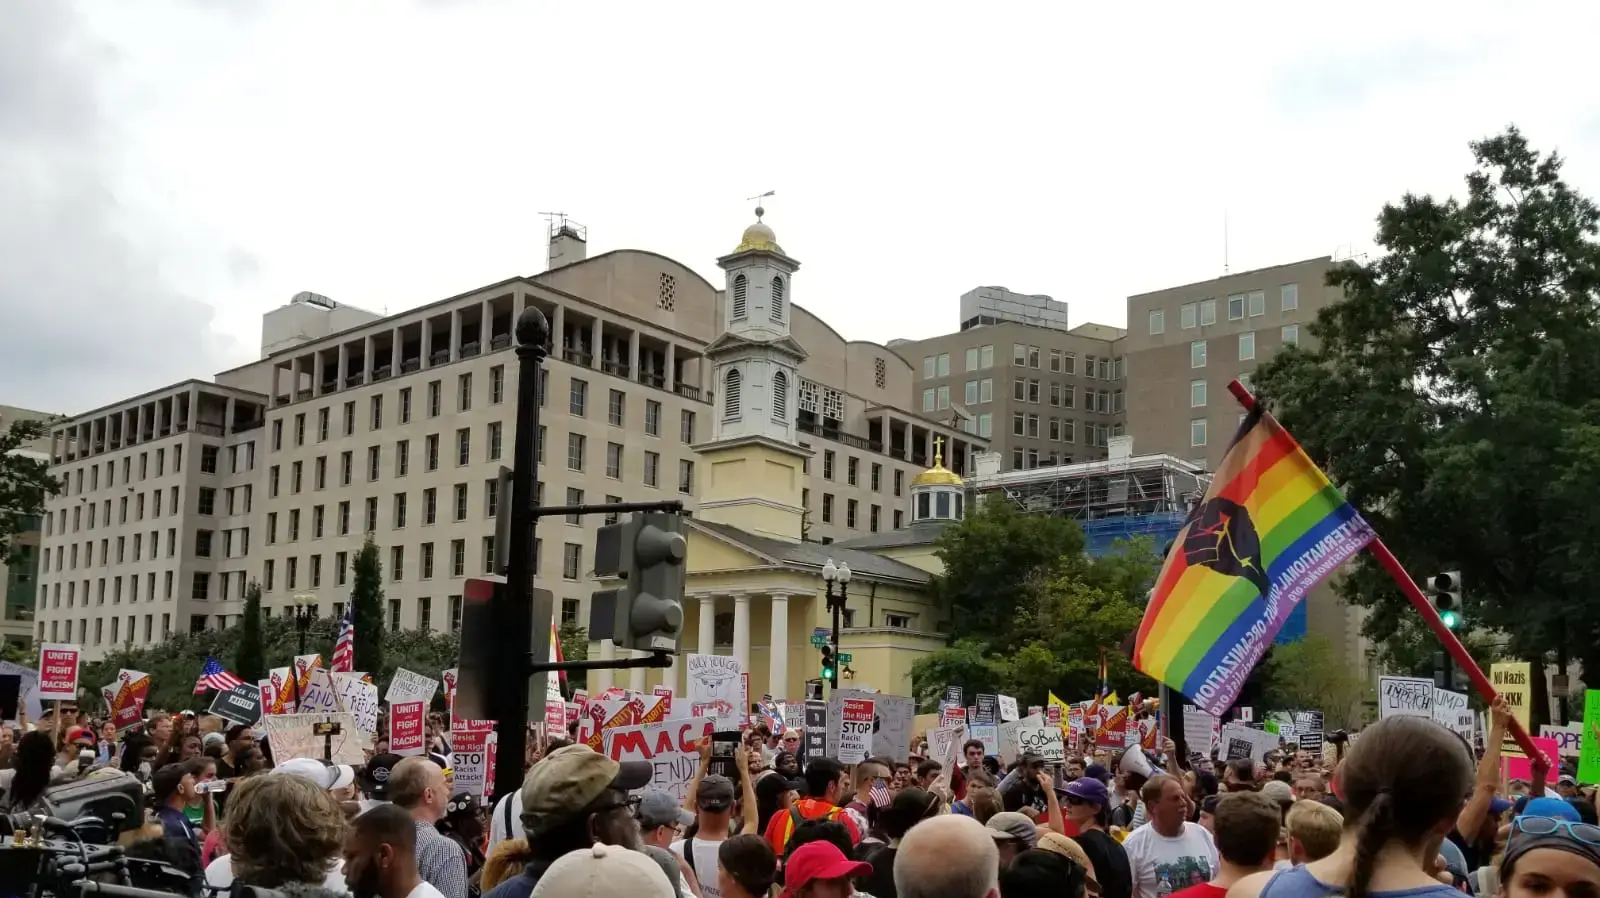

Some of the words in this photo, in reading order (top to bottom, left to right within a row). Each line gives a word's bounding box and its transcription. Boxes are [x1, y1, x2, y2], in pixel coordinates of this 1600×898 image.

[47, 651, 74, 661] UNITE
[46, 665, 73, 675] FIGHT
[1494, 672, 1503, 685] NO
[1503, 671, 1526, 685] Nazis
[41, 680, 74, 689] RACISM
[303, 688, 335, 708] AND
[1433, 690, 1465, 711] UMP
[397, 703, 420, 714] UNITE
[844, 701, 865, 711] Resist
[396, 719, 418, 730] FIGHT
[842, 721, 871, 733] STOP
[393, 735, 422, 746] RACISM
[841, 733, 862, 742] Racist
[453, 742, 465, 751] the
[467, 742, 484, 753] Righ
[454, 764, 476, 772] Racist
